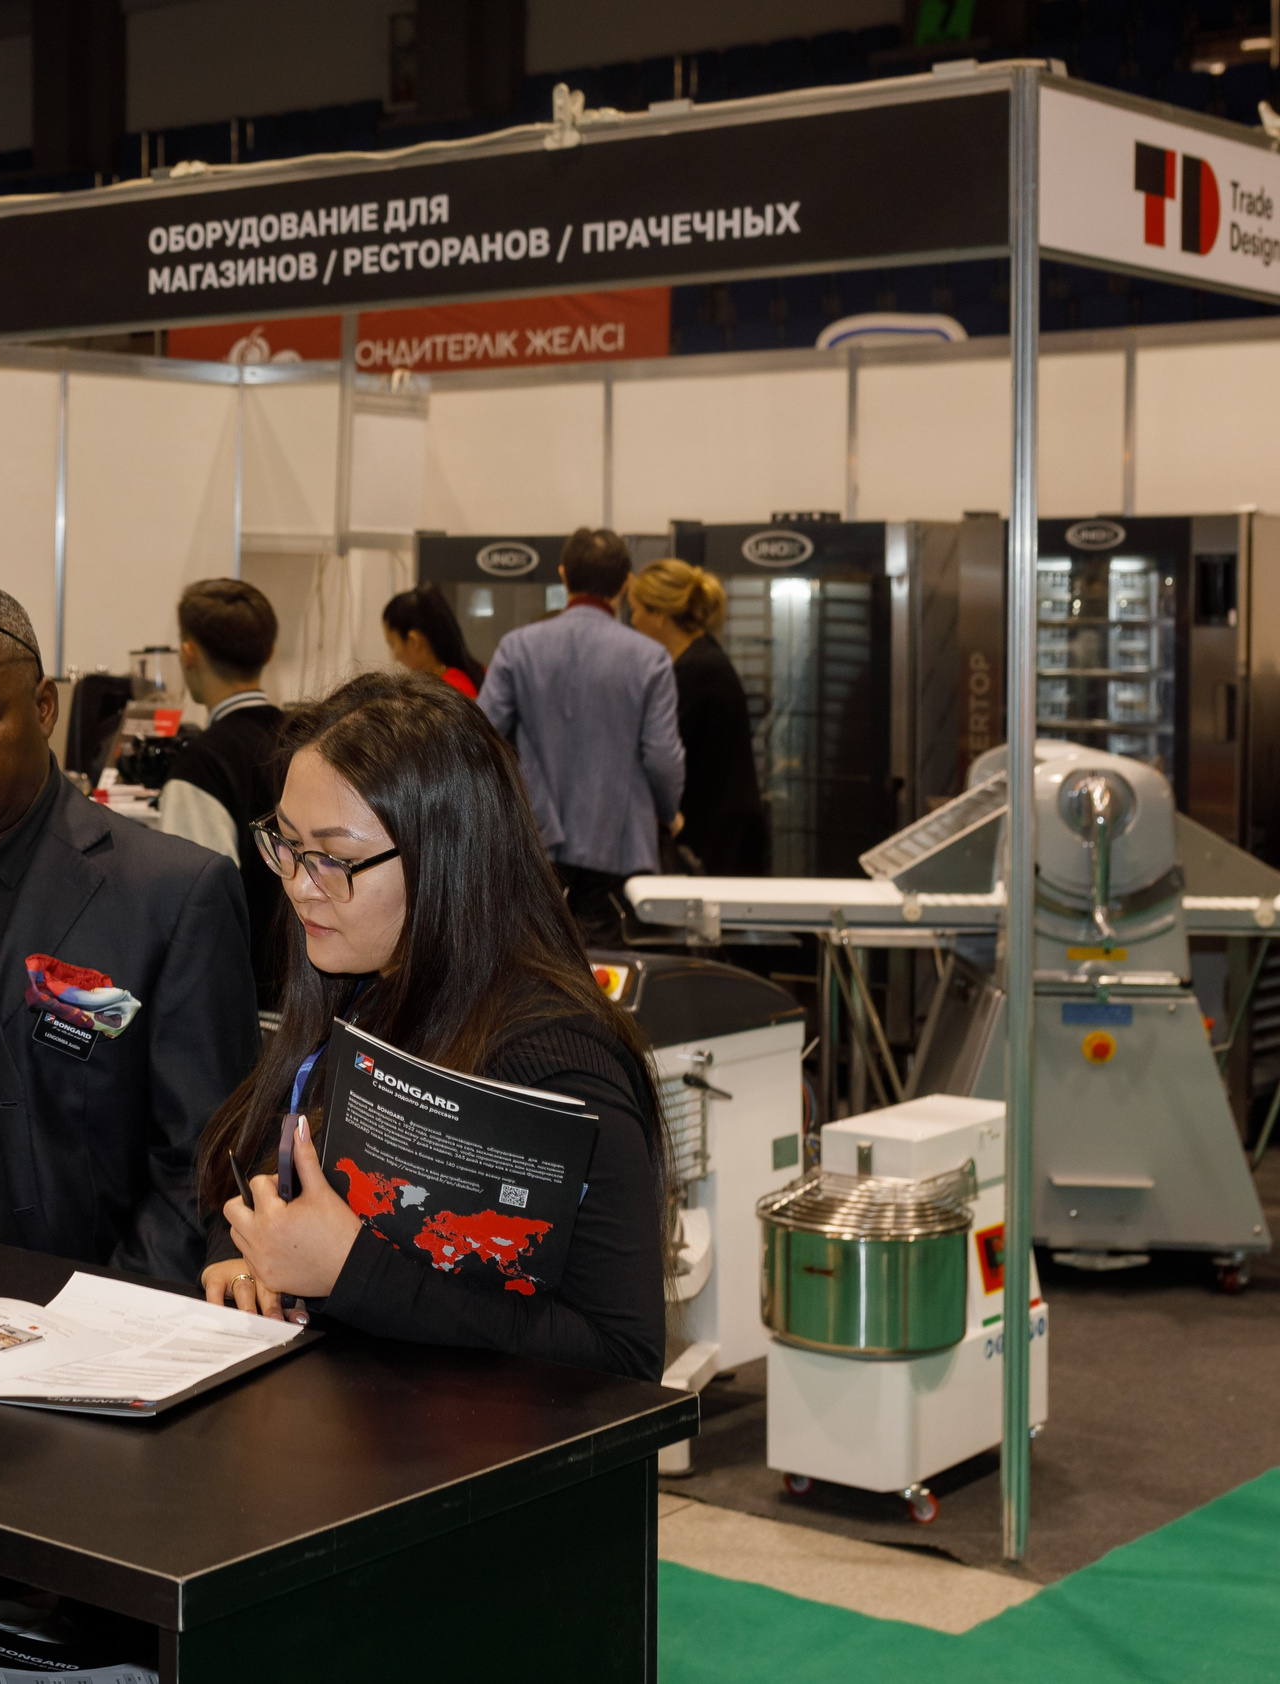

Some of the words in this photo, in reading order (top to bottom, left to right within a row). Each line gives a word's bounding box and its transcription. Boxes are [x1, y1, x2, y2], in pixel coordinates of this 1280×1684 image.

[1231, 180, 1273, 220] Trade
[148, 202, 379, 255] ОБОРУДОВАНИЕ
[384, 194, 449, 235] ДЛЯ
[148, 249, 318, 296] МАГАЗИНОВ
[343, 227, 551, 277] РЕСТОРАНОВ
[582, 201, 801, 254] ПРАЧЕЧНЫХ
[354, 329, 518, 368] ОНДИТЕРЛІК
[523, 323, 625, 357] ЖЕЛІСІ
[968, 651, 991, 753] ERTOP
[53, 1020, 92, 1040] BONGARD
[374, 1069, 459, 1113] BONGARD
[379, 1085, 393, 1095] вами
[395, 1092, 418, 1106] задолго
[430, 1108, 458, 1122] рассвета
